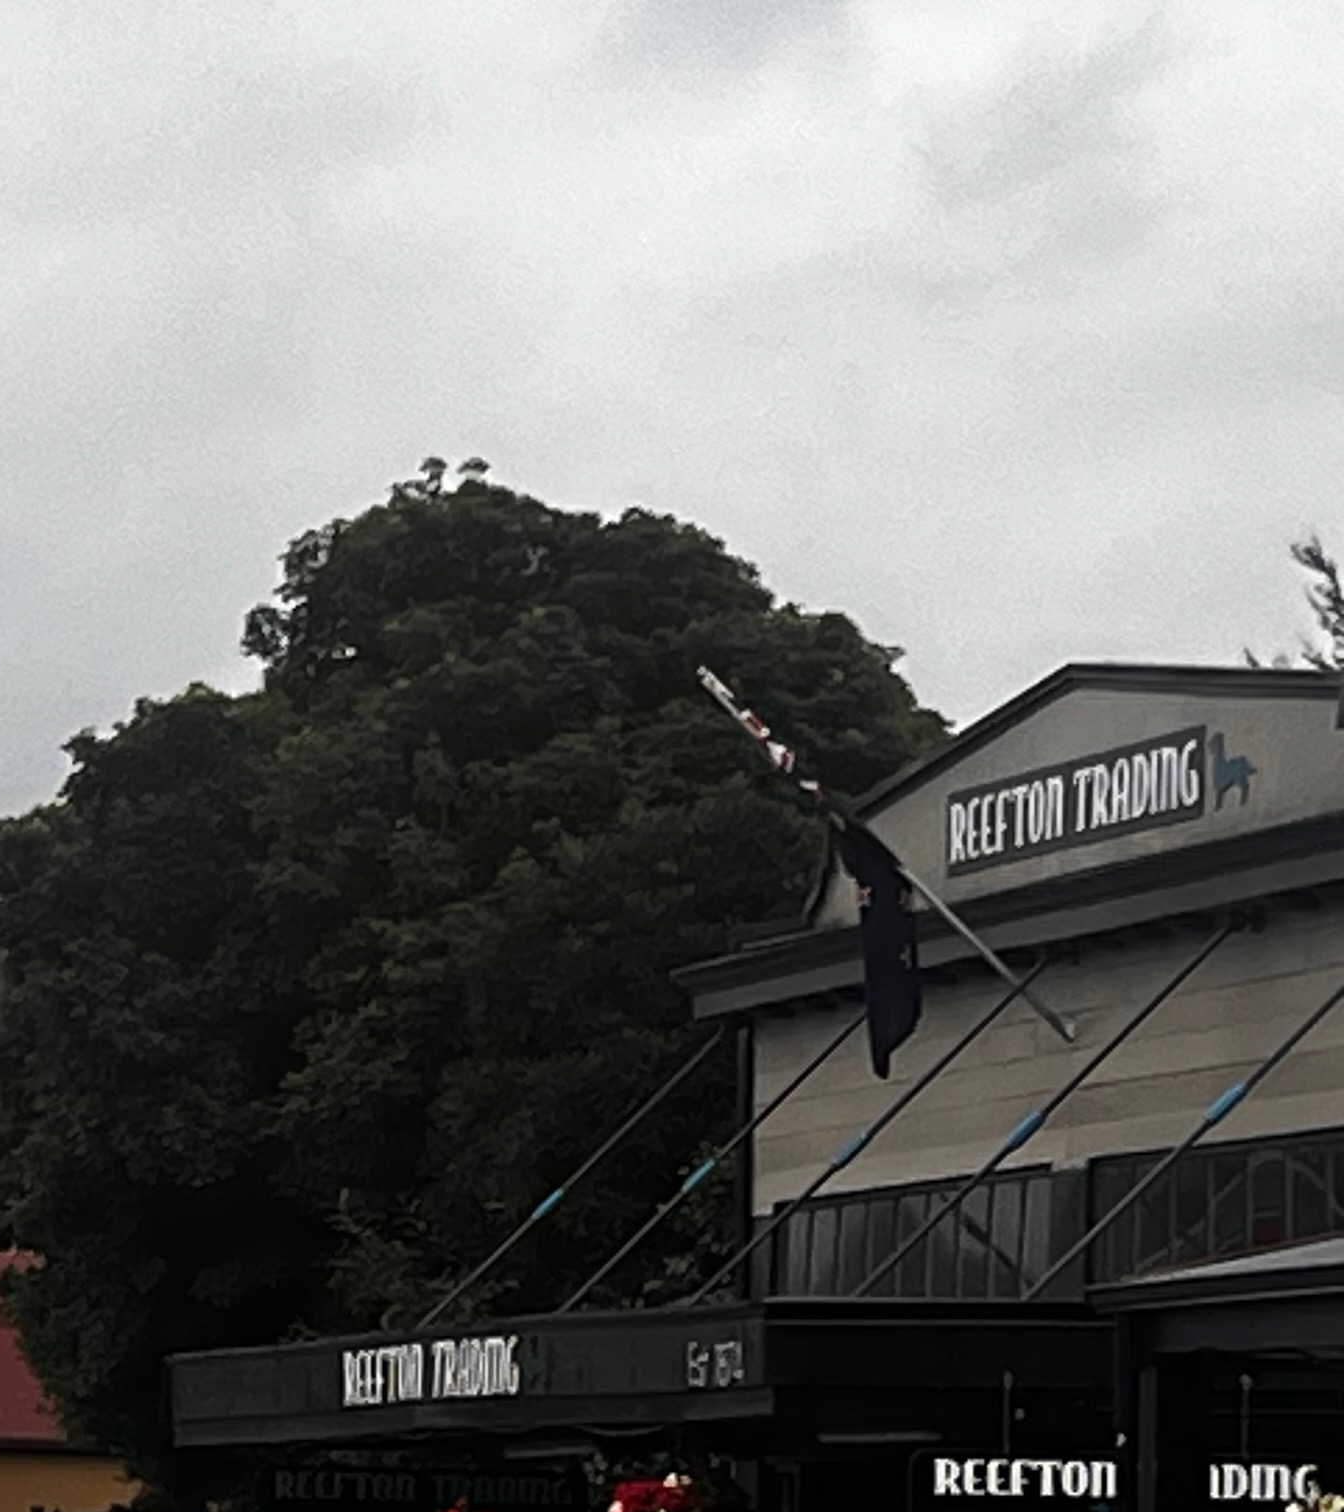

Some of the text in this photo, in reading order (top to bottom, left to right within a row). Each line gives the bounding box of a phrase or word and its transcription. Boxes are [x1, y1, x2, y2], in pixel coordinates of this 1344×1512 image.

[949, 739, 1200, 864] REEFTON TRADING
[430, 1335, 518, 1399] TRADING
[933, 1458, 1319, 1500] REEFTON DING
